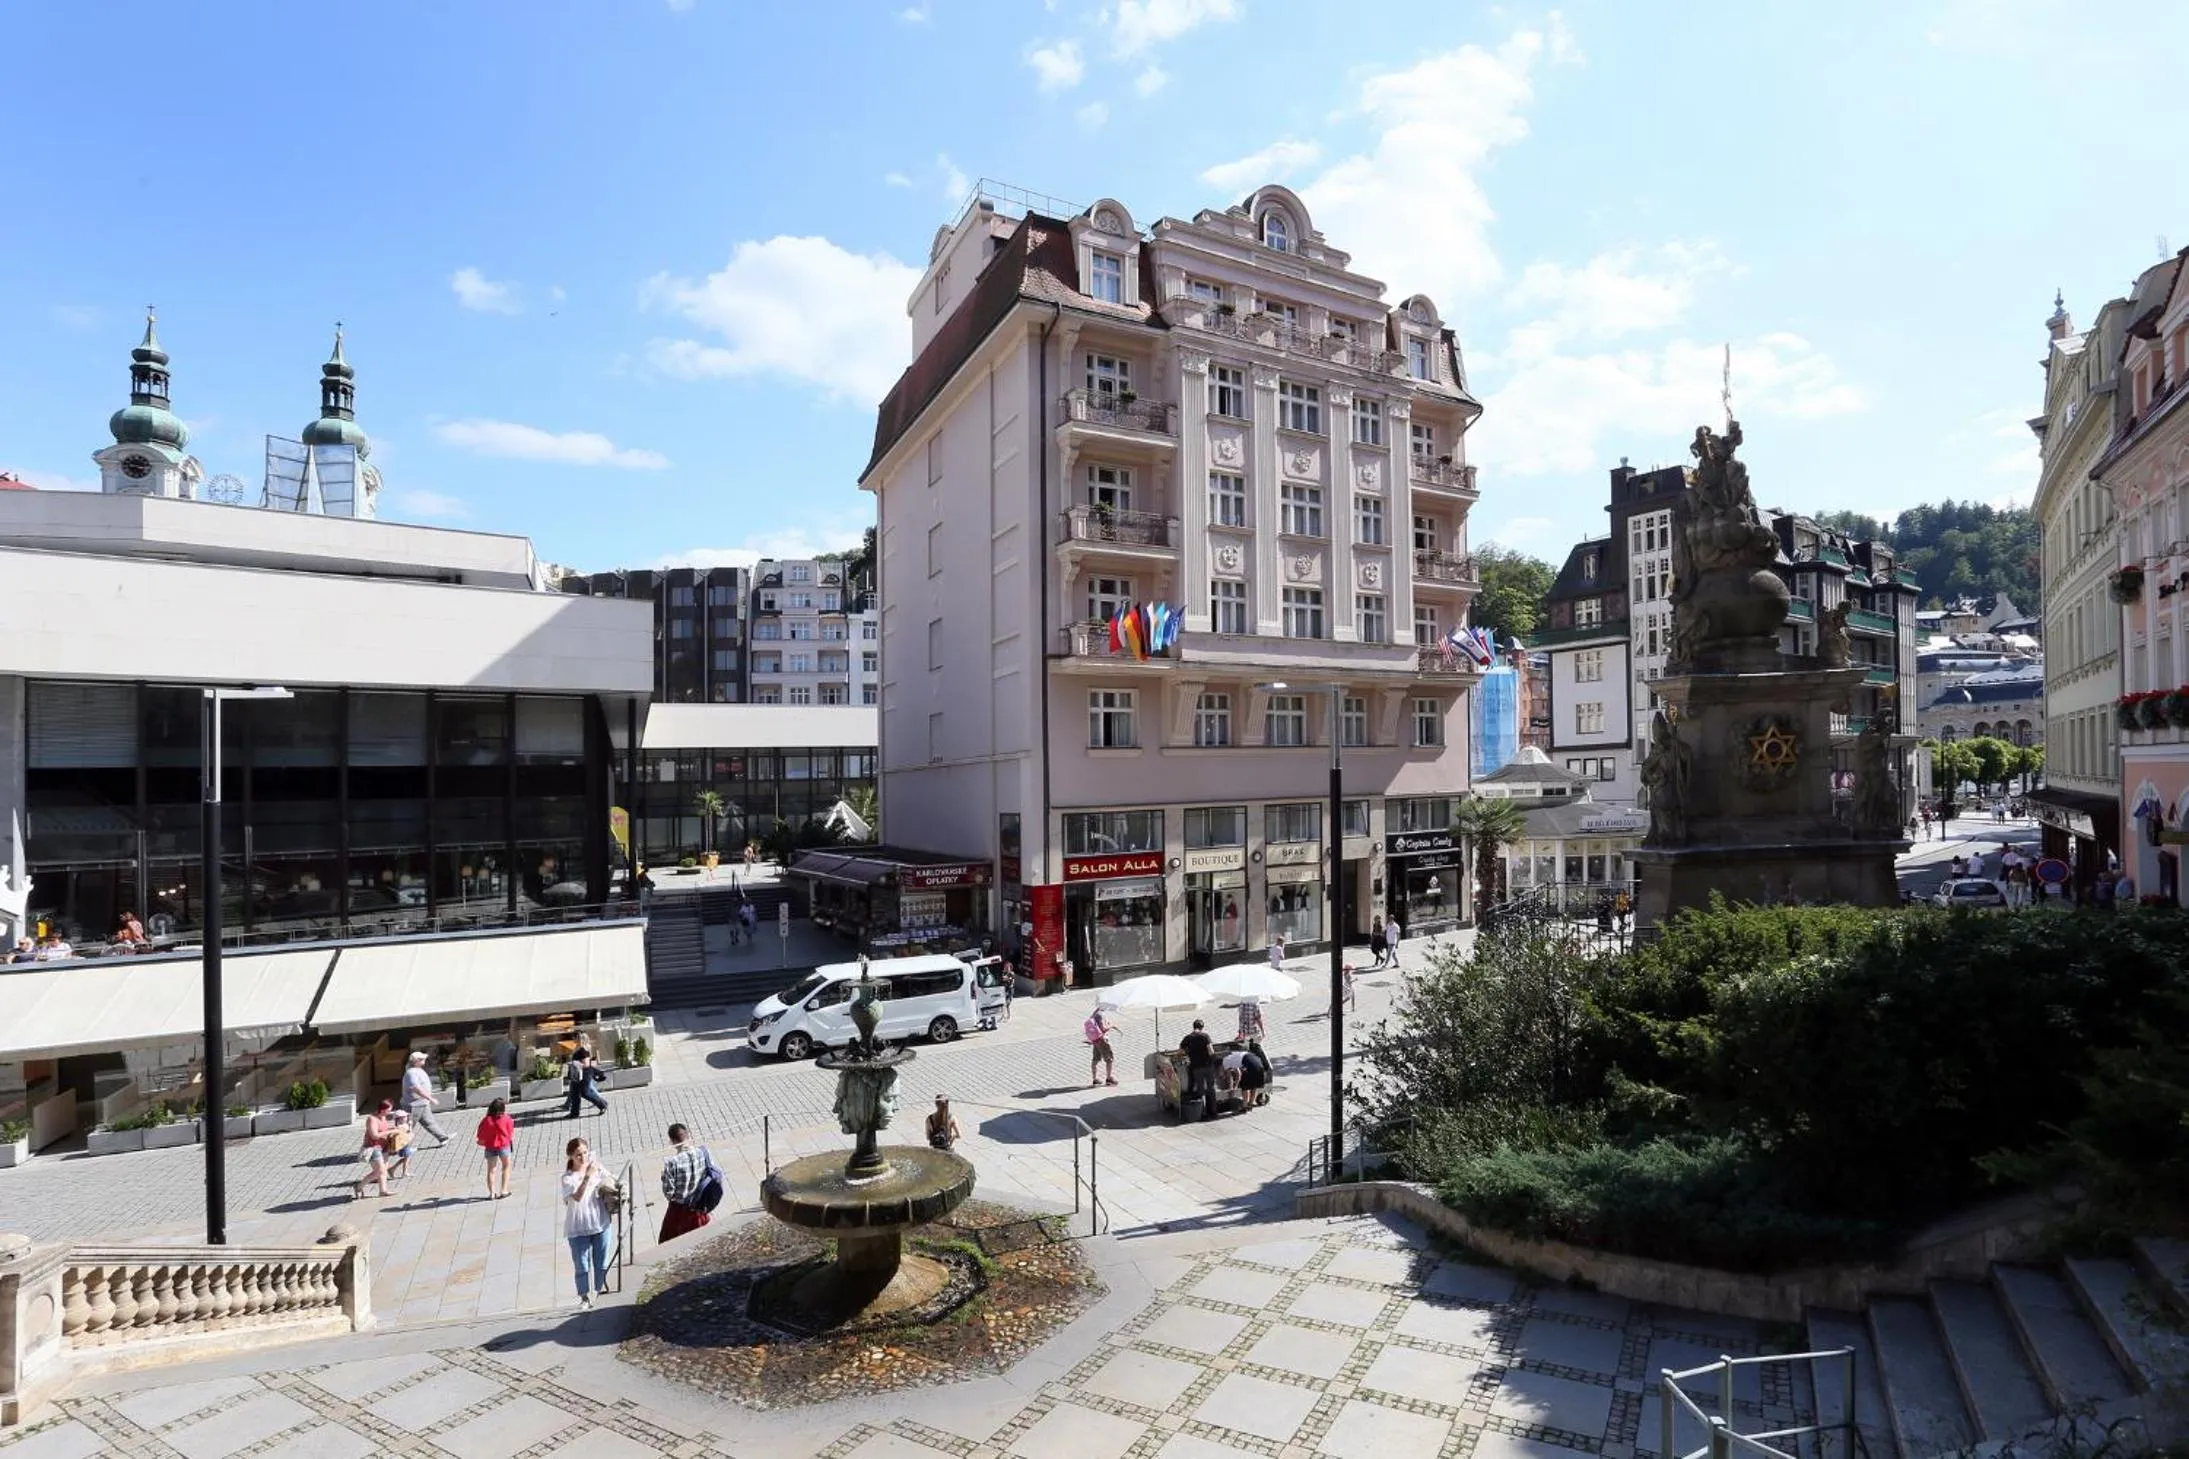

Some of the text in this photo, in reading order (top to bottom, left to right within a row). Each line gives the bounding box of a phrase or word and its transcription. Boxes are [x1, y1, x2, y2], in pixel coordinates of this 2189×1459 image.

[1123, 860, 1159, 871] ALLA
[1191, 854, 1239, 867] BOUTIQUE
[926, 876, 959, 885] OPLATKY
